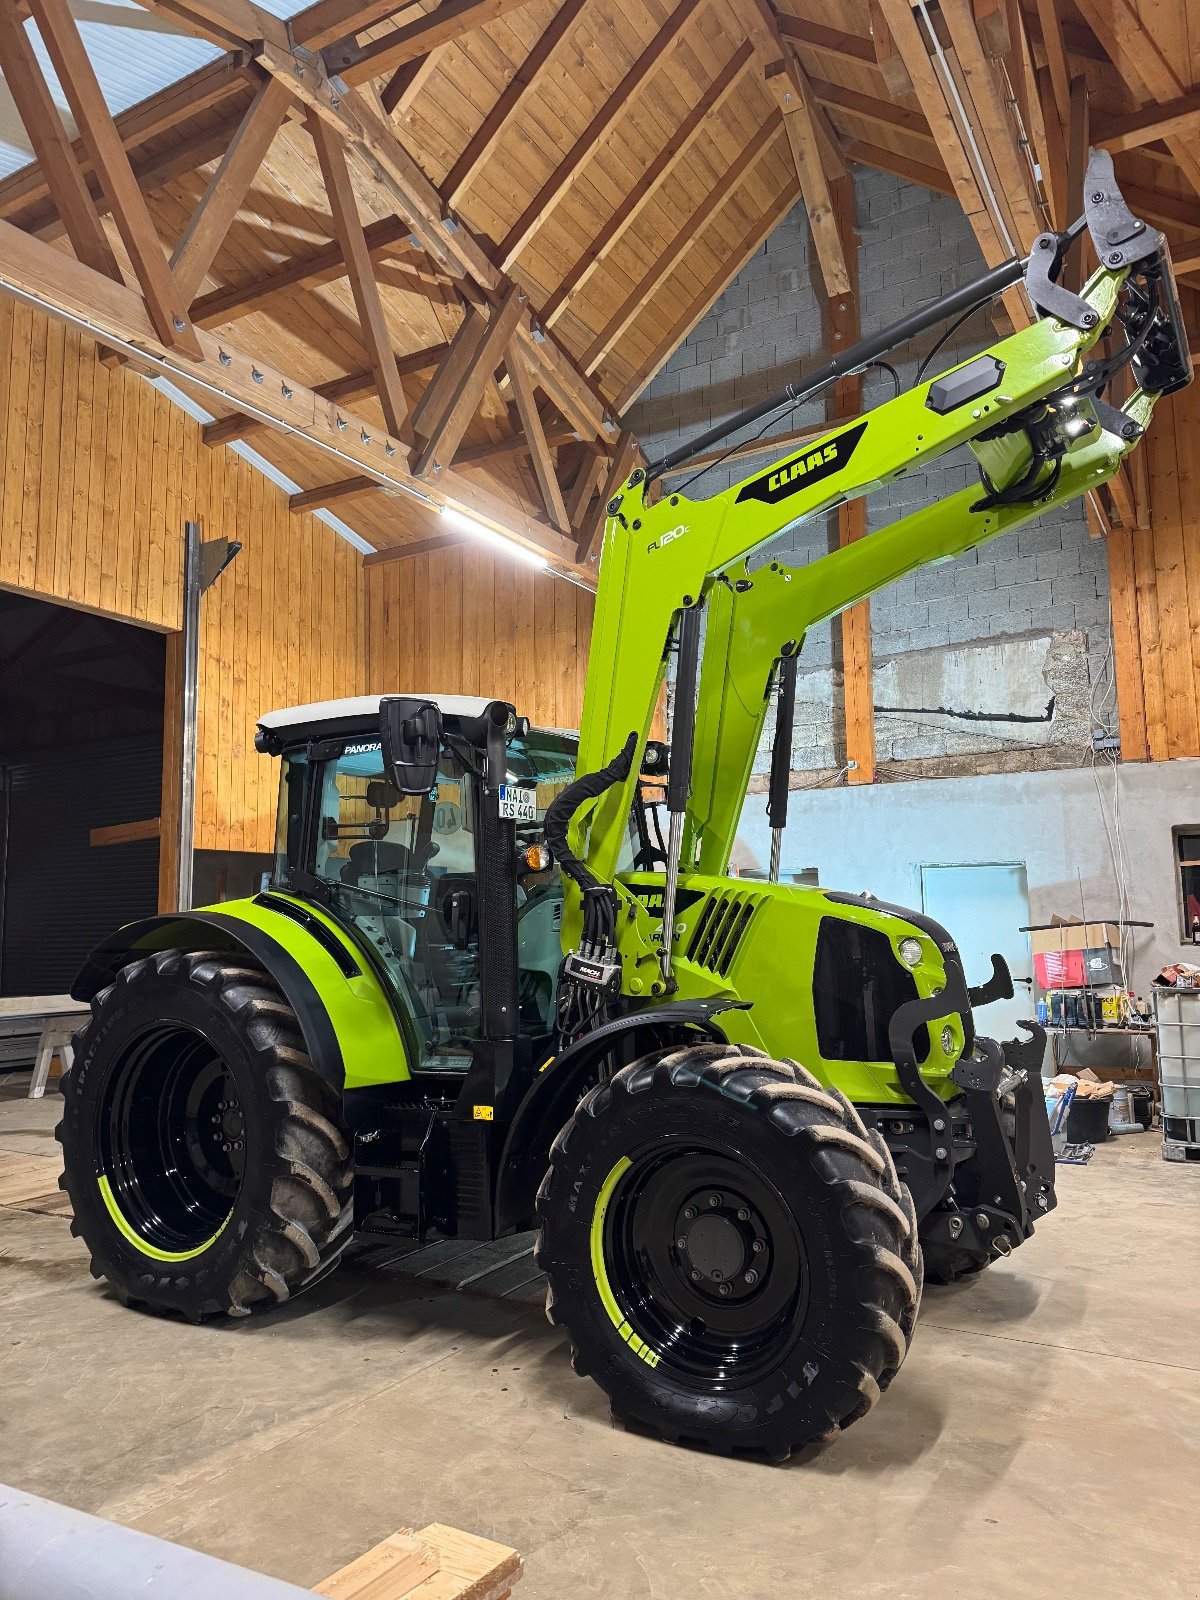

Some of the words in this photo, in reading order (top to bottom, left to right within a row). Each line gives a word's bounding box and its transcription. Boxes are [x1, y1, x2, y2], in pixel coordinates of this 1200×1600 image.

[768, 442, 838, 492] CLAAS
[506, 787, 523, 804] NAI
[503, 802, 515, 817] RS
